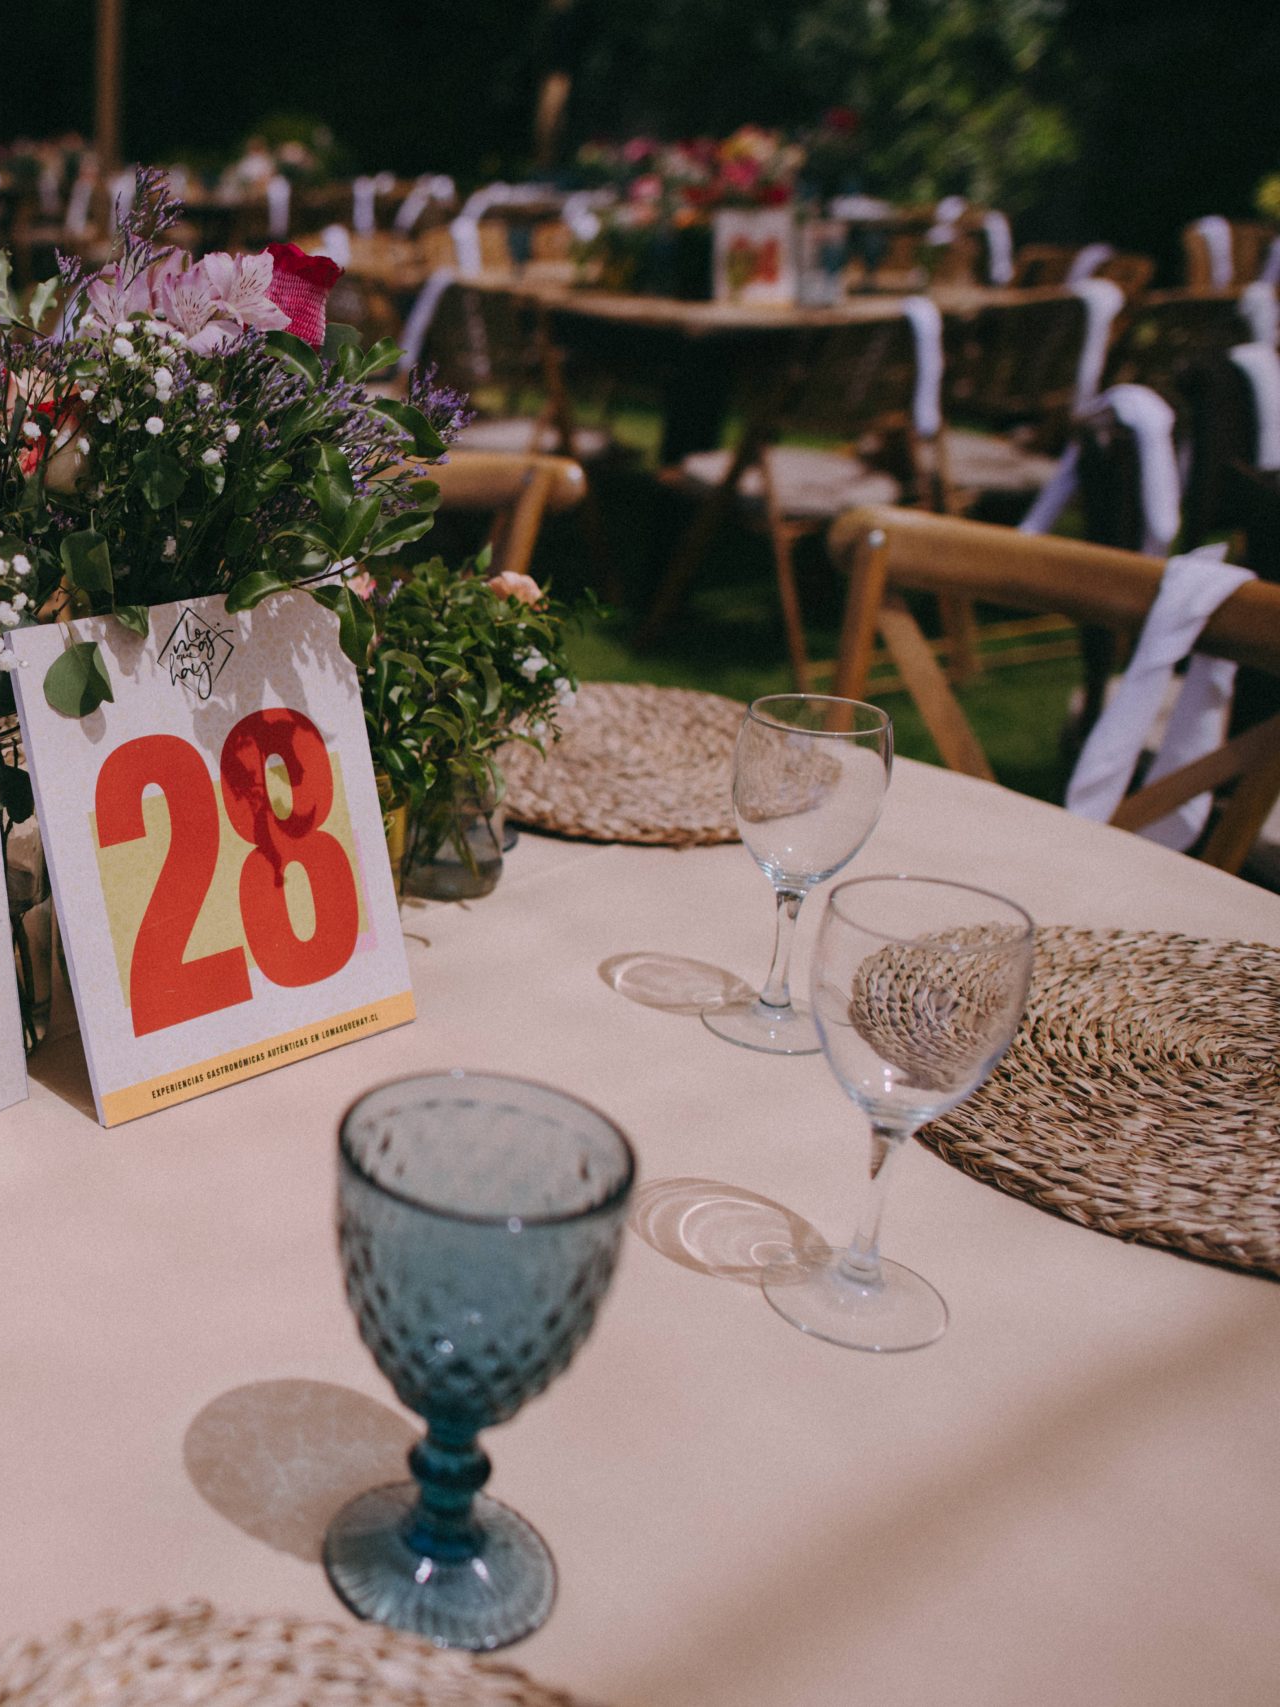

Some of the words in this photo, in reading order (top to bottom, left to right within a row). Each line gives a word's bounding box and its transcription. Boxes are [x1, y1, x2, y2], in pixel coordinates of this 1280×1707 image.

[95, 707, 358, 1037] 28
[152, 1073, 204, 1098] EXPERIENCIAS
[207, 1052, 265, 1080] GASTRONÓMICAS
[268, 1037, 308, 1058] AUTÉNTICAS
[310, 1032, 320, 1044] EN
